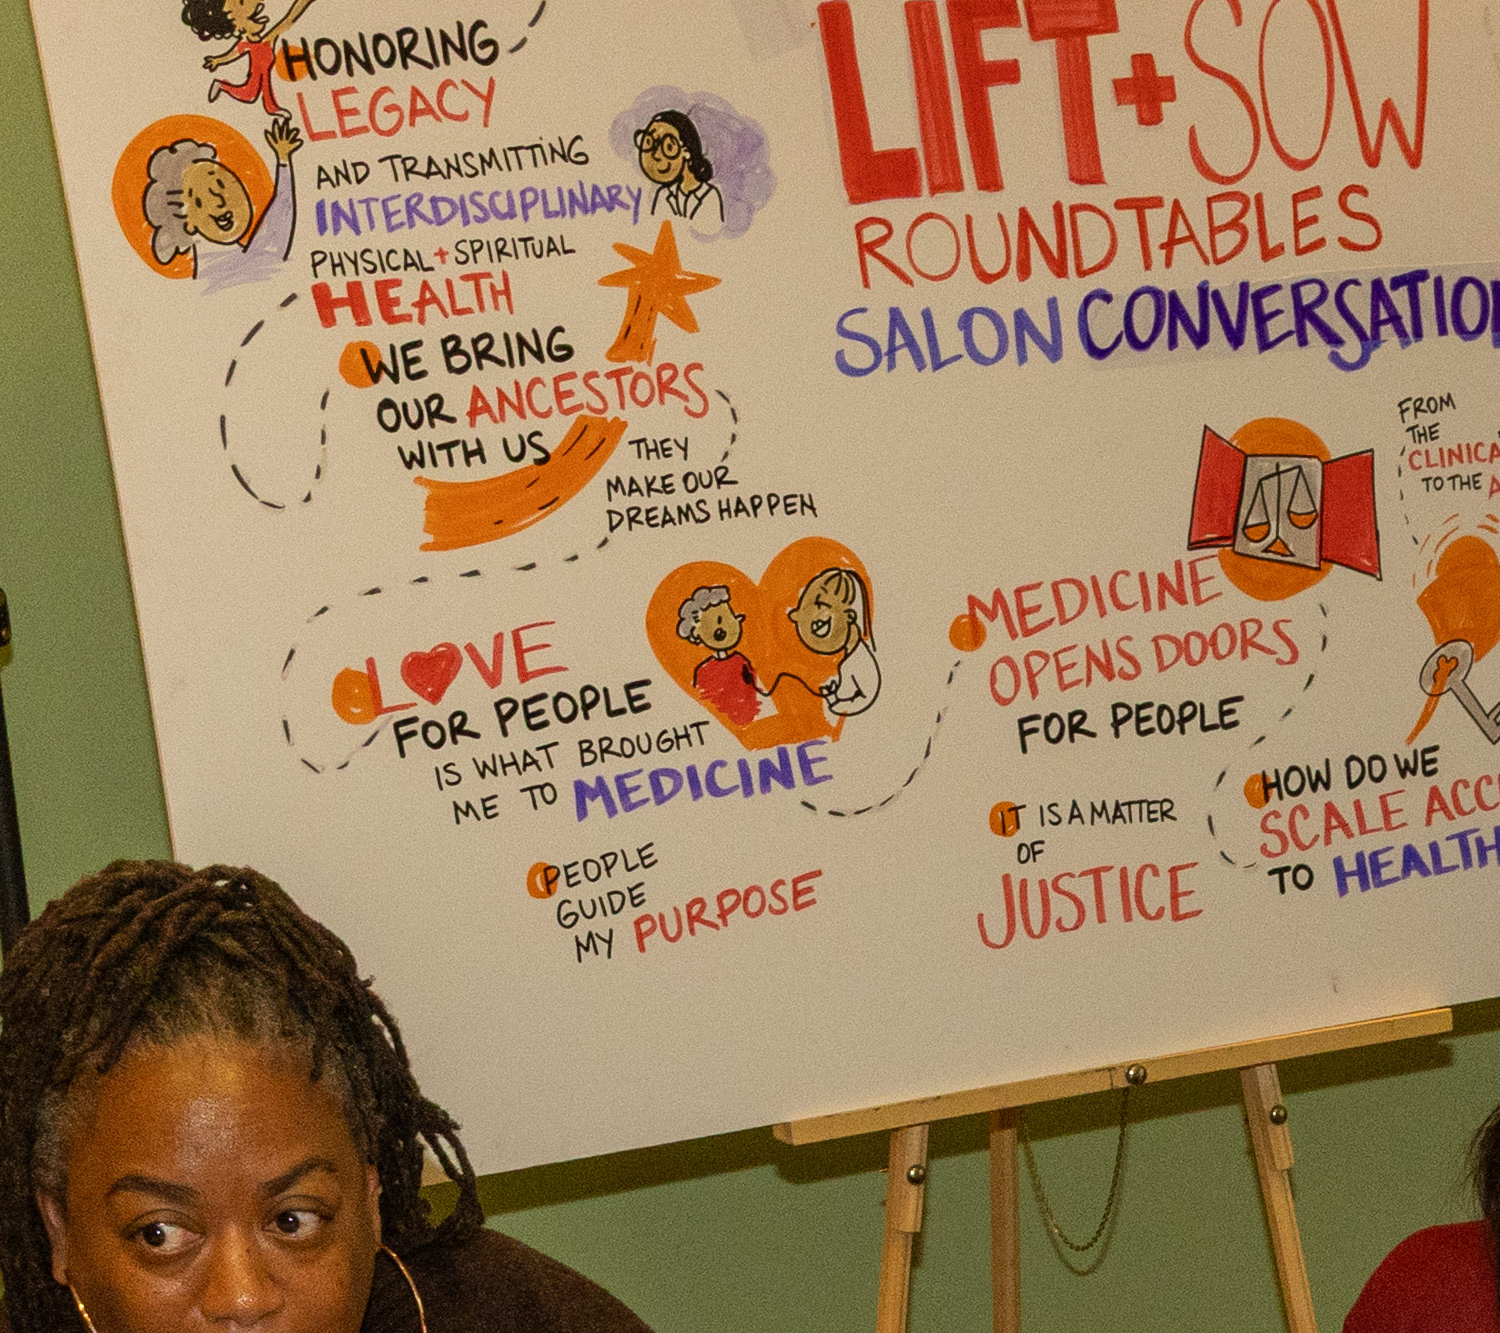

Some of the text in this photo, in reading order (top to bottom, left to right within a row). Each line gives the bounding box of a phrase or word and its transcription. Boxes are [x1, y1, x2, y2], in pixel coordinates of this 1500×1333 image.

[282, 20, 499, 82] HONORING
[298, 77, 497, 144] LEGACY
[316, 157, 371, 190] AND
[314, 179, 643, 237] INTERDISCIPLINARY
[854, 184, 1385, 289] ROUNDTABLES
[309, 243, 432, 277] PHYSICAL
[454, 232, 576, 264] SPIRITUAL
[311, 270, 514, 328] HEALTH
[361, 324, 575, 386] WE BRING
[834, 292, 1063, 379] SALON
[376, 361, 710, 434] OUR ANCESTORS
[1398, 394, 1455, 422] FROM
[398, 429, 552, 471] WITH US
[627, 437, 690, 463] THEY
[1406, 423, 1440, 444] THE
[606, 465, 738, 502] MAKE OUR
[1421, 475, 1445, 492] TO
[1447, 474, 1483, 491] THE
[606, 491, 818, 534] DREAMS HAPPEN
[968, 554, 1225, 645] MEDICINE
[989, 617, 1301, 707] OPENS DOORS
[391, 679, 652, 757] FOR PEOPLE
[1016, 695, 1244, 754] FOR PEOPLE
[436, 722, 710, 790] IS WHAT BROUGHT
[452, 738, 834, 825] ME TO MEDICINE
[1262, 746, 1440, 801] HOW DO WE
[1001, 799, 1177, 834] IT IS A MATTER
[1259, 787, 1407, 858] SCALE
[544, 842, 659, 894] PEOPLE
[1016, 841, 1046, 865] OF
[1269, 865, 1314, 896] TO
[555, 882, 646, 929] GUIDE
[575, 870, 824, 963] MY PURPOSE
[977, 862, 1203, 949] JUSTICE
